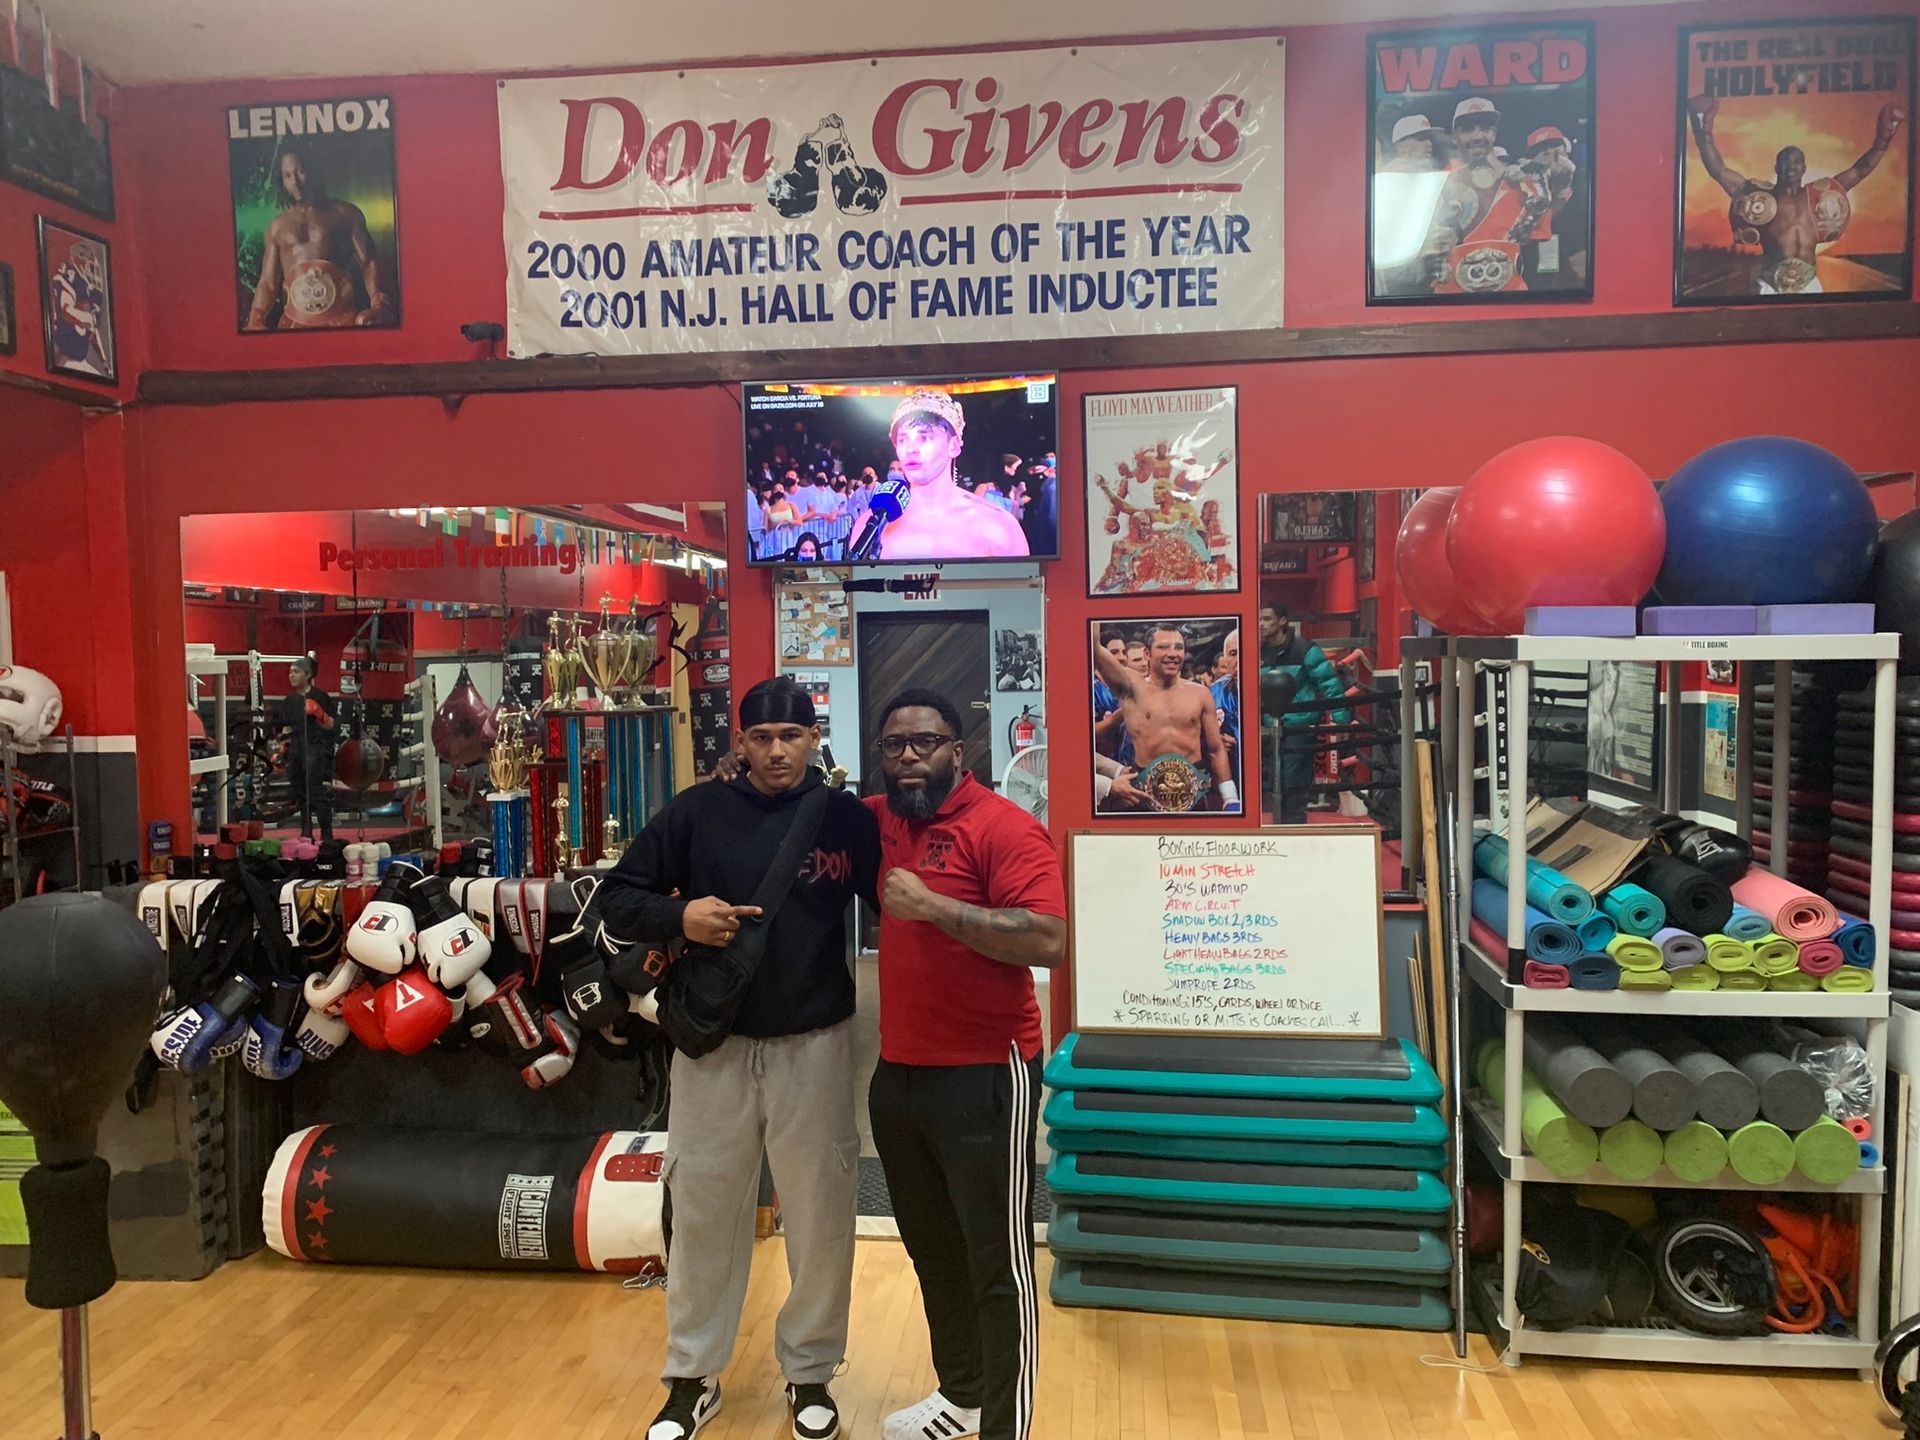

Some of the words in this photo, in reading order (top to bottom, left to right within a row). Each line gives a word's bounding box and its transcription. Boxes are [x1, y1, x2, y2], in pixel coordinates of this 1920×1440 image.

[1378, 38, 1588, 93] WARD
[1696, 40, 1748, 62] THE
[1757, 36, 1826, 59] REAL
[1704, 60, 1897, 98] HOLYFIELD
[228, 98, 390, 139] LENNOX
[550, 96, 775, 192] Don
[872, 76, 1246, 178] Givens
[527, 240, 626, 281] 2000
[640, 233, 821, 279] AMATEUR
[837, 225, 975, 271] COACH
[991, 222, 1040, 264] OF
[1055, 218, 1126, 262] THE
[1141, 214, 1252, 258] YEAR
[560, 289, 647, 329] 2001
[660, 287, 728, 328] N.J.
[741, 283, 833, 325] HALL
[848, 280, 896, 322] OF
[910, 274, 1013, 319] FAME
[1029, 266, 1218, 314] INDUCTEE
[1091, 399, 1128, 417] FLOYD
[1131, 393, 1213, 415] MAYWEATHER
[319, 538, 444, 571] Personal
[453, 534, 577, 574] Training
[904, 573, 940, 600] EXIT
[506, 907, 520, 934] RINGSIDE
[504, 1190, 516, 1221] FIGHT
[503, 1222, 513, 1257] SPORTS
